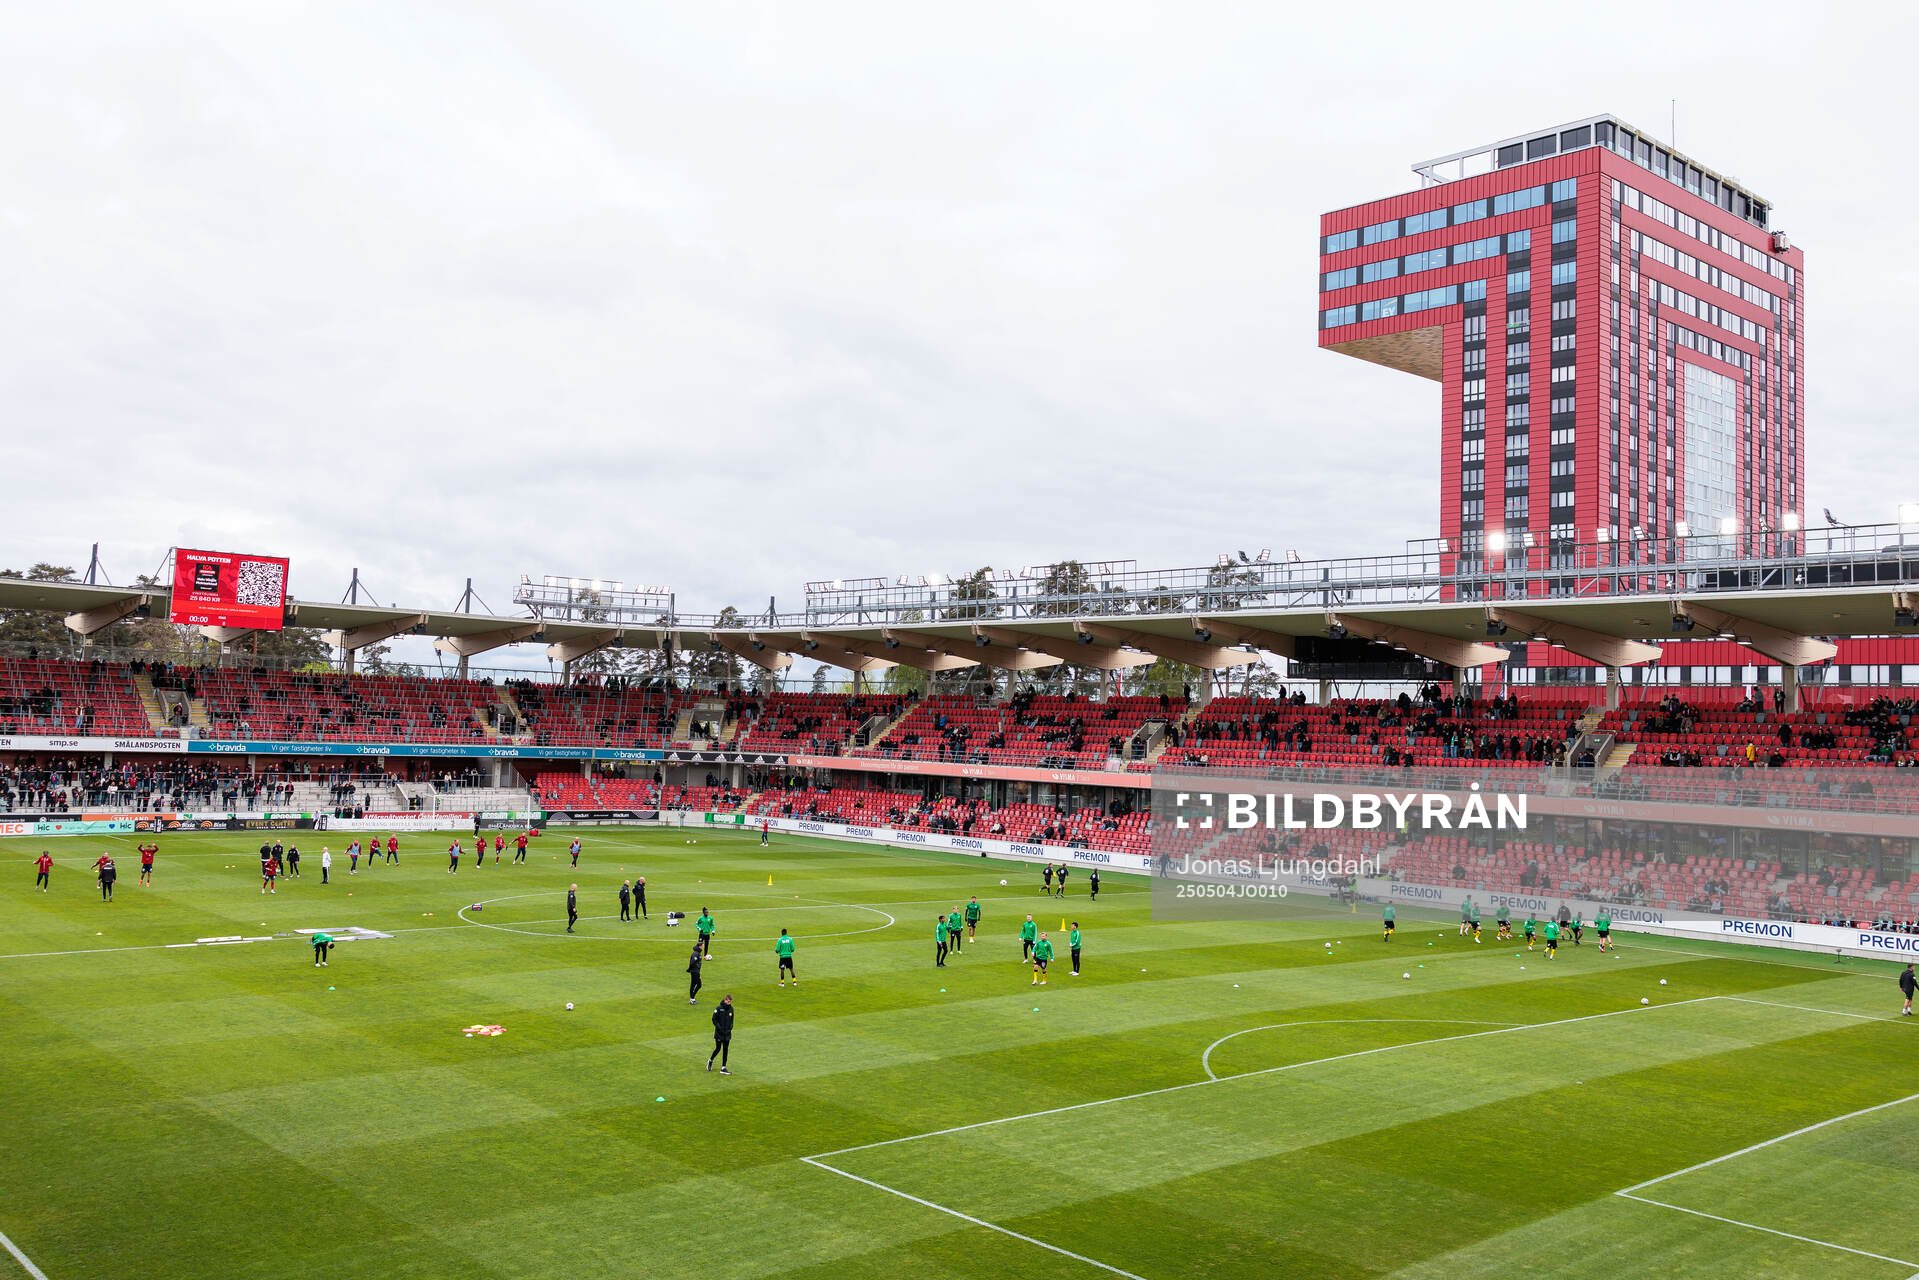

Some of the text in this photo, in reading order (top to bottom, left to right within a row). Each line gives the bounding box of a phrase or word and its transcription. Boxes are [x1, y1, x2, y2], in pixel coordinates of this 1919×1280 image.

[114, 740, 180, 748] SMÅLANDSPOSTEN
[216, 742, 246, 752] bravida
[363, 746, 390, 754] bravida
[1598, 804, 1624, 815] VISMA
[755, 818, 778, 826] PRMON
[1782, 814, 1815, 828] VISMA
[798, 822, 824, 832] PREMON
[846, 828, 872, 837] PREMON
[896, 832, 926, 842] PREMON
[952, 838, 982, 849] PREMON
[1010, 844, 1044, 856] PREMON
[1074, 851, 1110, 863] PREMON
[1391, 884, 1442, 900] PREMON
[1722, 920, 1792, 938] PREMON
